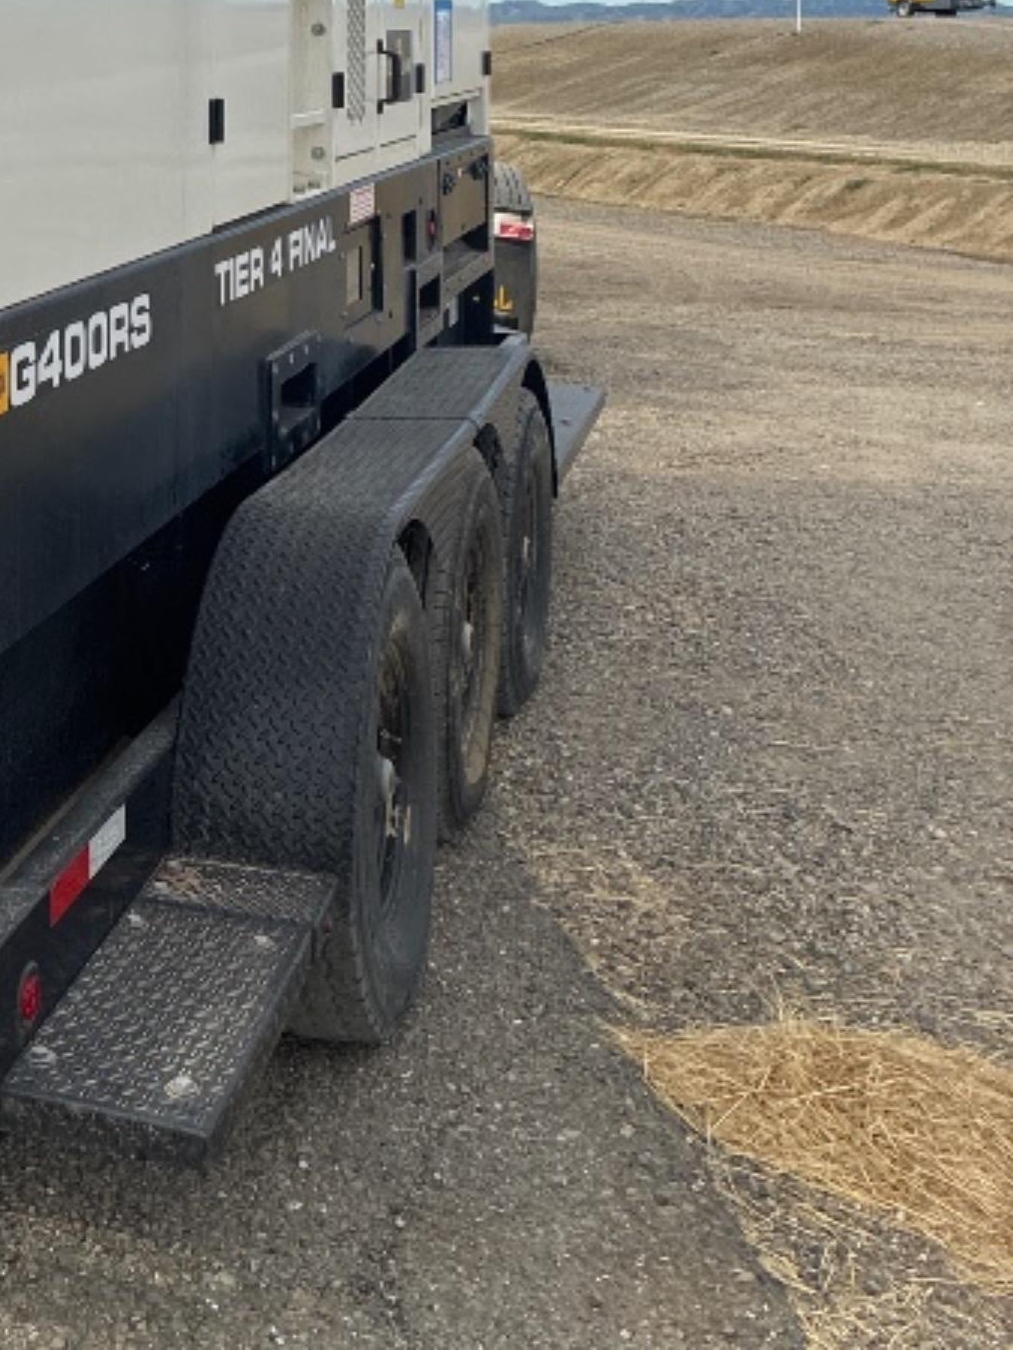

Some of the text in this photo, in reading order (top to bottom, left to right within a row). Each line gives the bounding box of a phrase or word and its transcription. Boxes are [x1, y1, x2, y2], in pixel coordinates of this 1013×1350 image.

[214, 214, 336, 307] TIER 4 FINAL
[9, 293, 151, 408] G400RS
